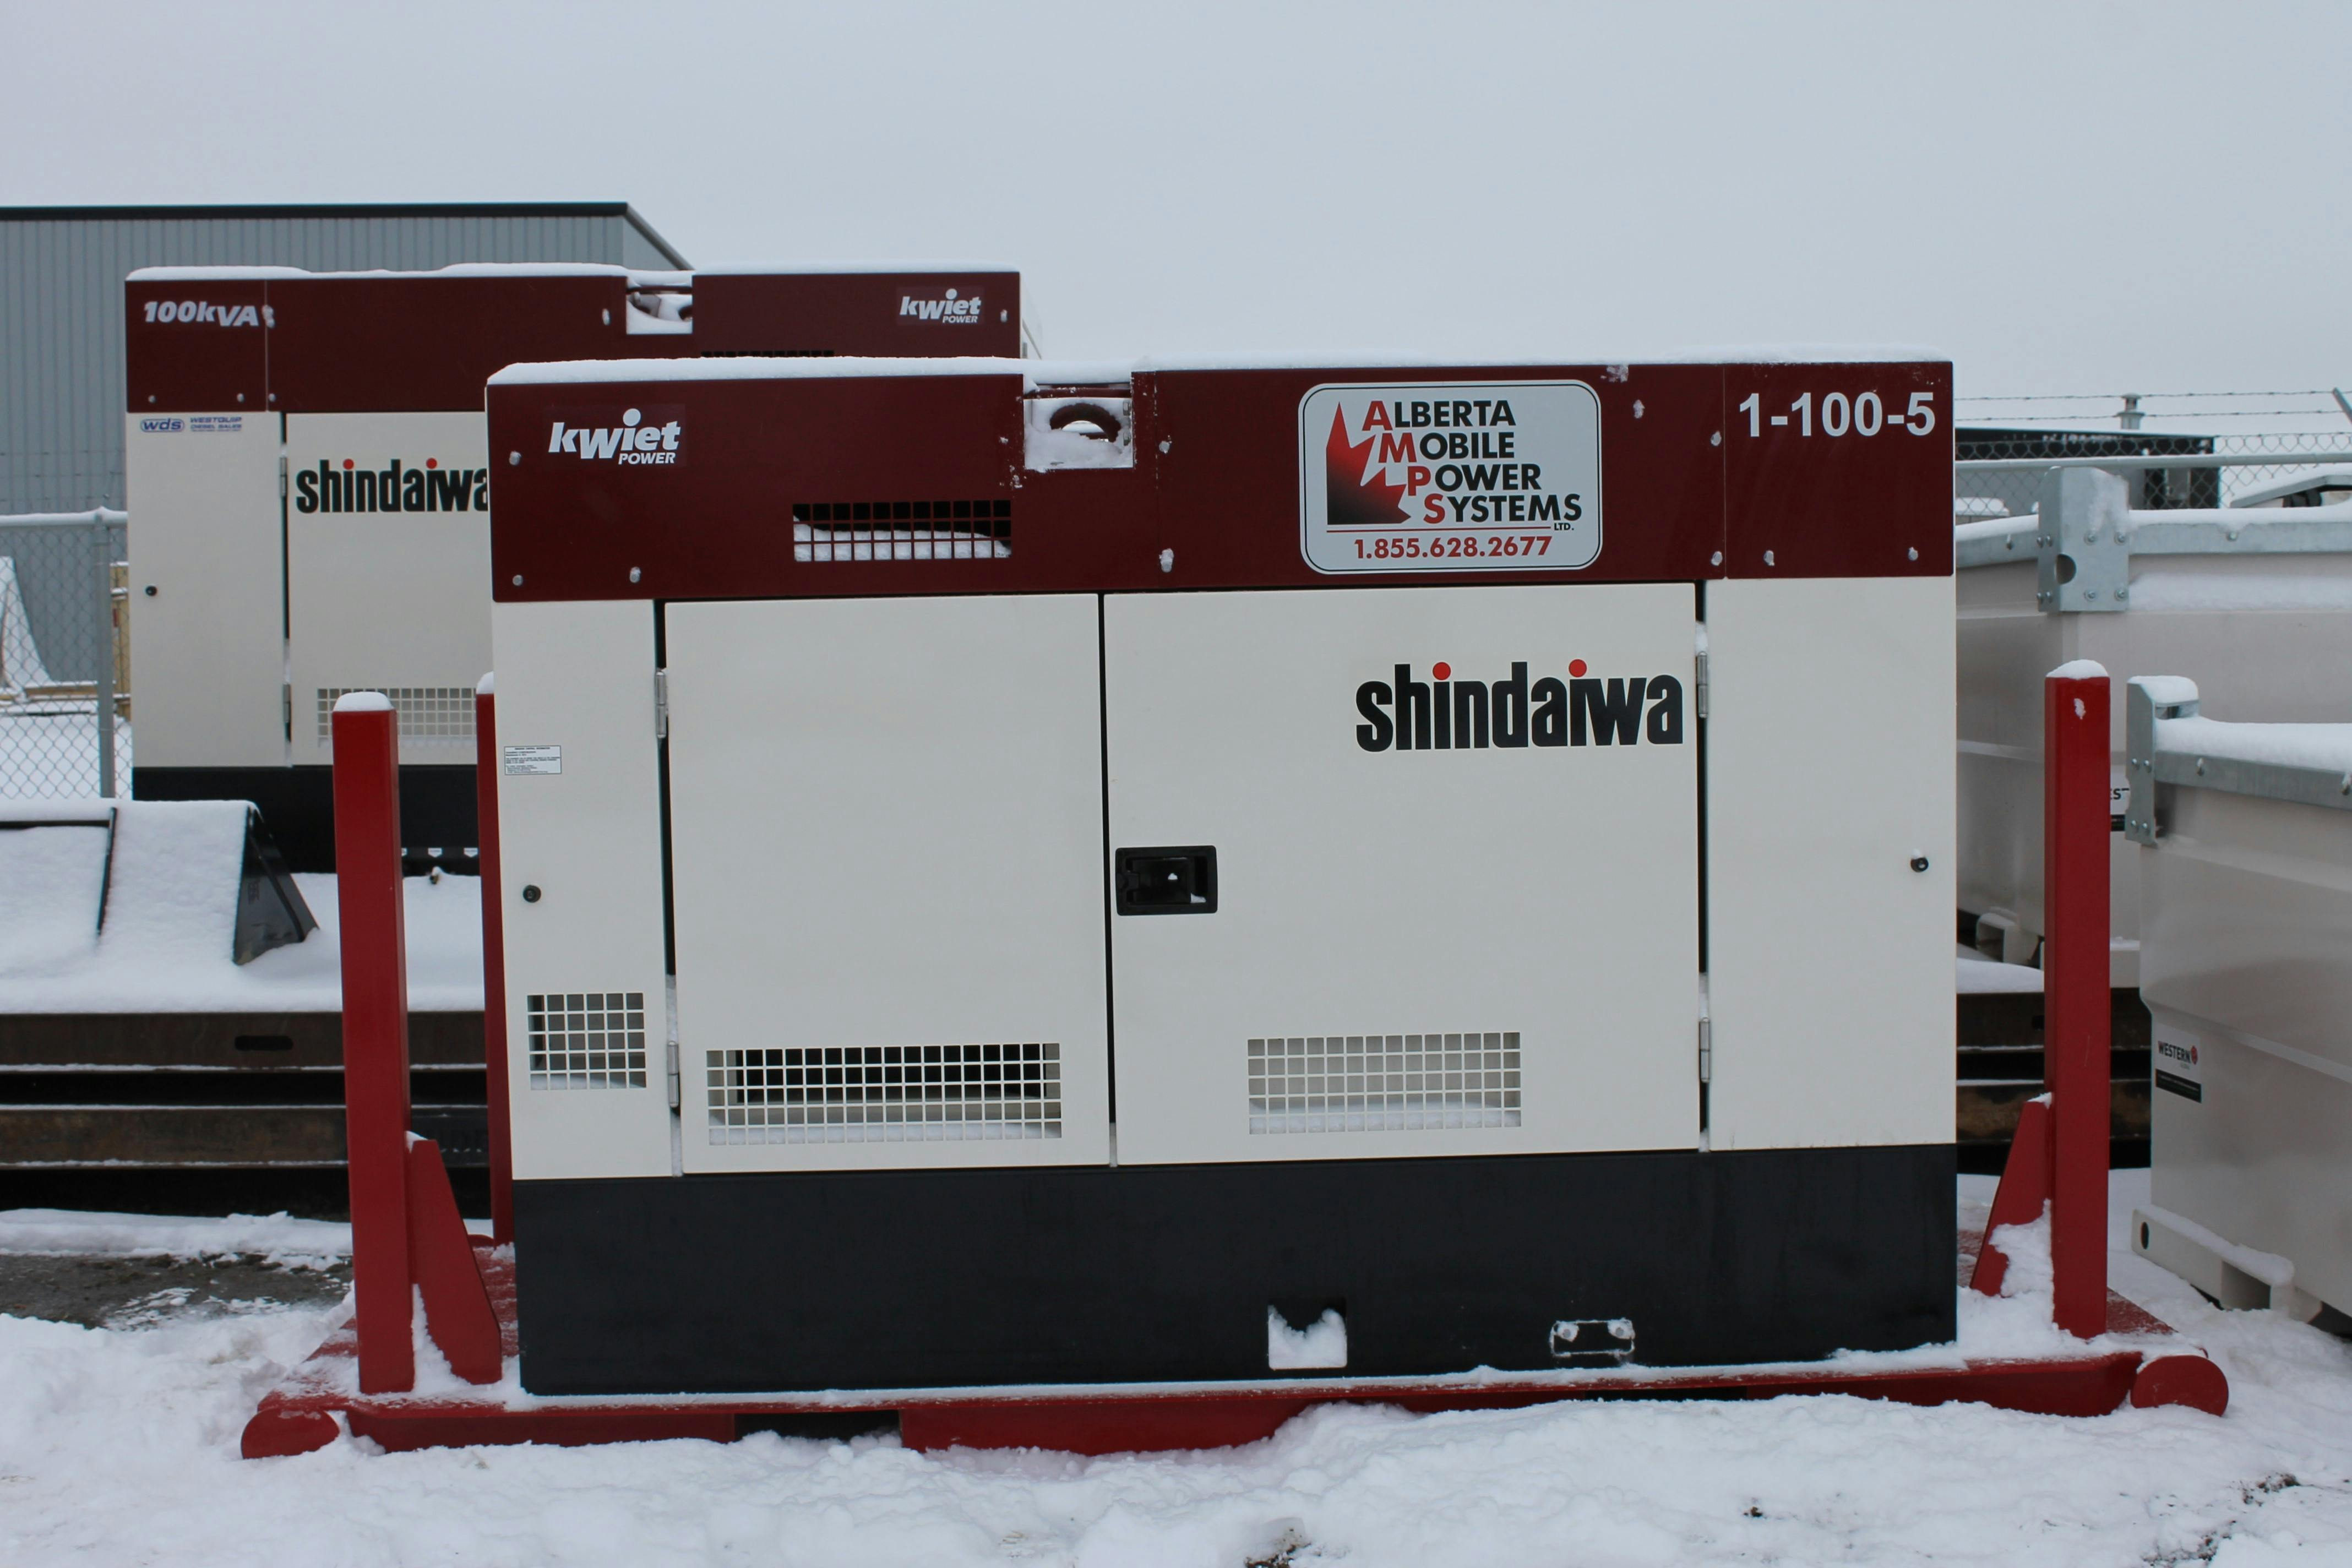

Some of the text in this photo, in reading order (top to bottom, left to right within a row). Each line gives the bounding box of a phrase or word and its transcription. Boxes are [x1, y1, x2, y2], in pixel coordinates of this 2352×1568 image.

[144, 301, 259, 326] 100kVA
[900, 288, 981, 319] kwiet
[143, 418, 182, 430] wds
[1362, 400, 1516, 431] ALBERTA
[1740, 391, 1935, 437] 1-100-5
[548, 408, 681, 459] kwiet
[1379, 432, 1515, 464] MOBILE
[618, 453, 676, 465] POWER
[296, 458, 488, 514] shindaiwa
[1407, 464, 1542, 496] POWER
[1423, 493, 1582, 524] SYSTEMS
[1553, 522, 1575, 531] LTD.
[1354, 536, 1553, 559] 1.855.628.2677
[1356, 659, 1683, 753] shindaiwa
[2158, 1041, 2191, 1063] WESTERN
